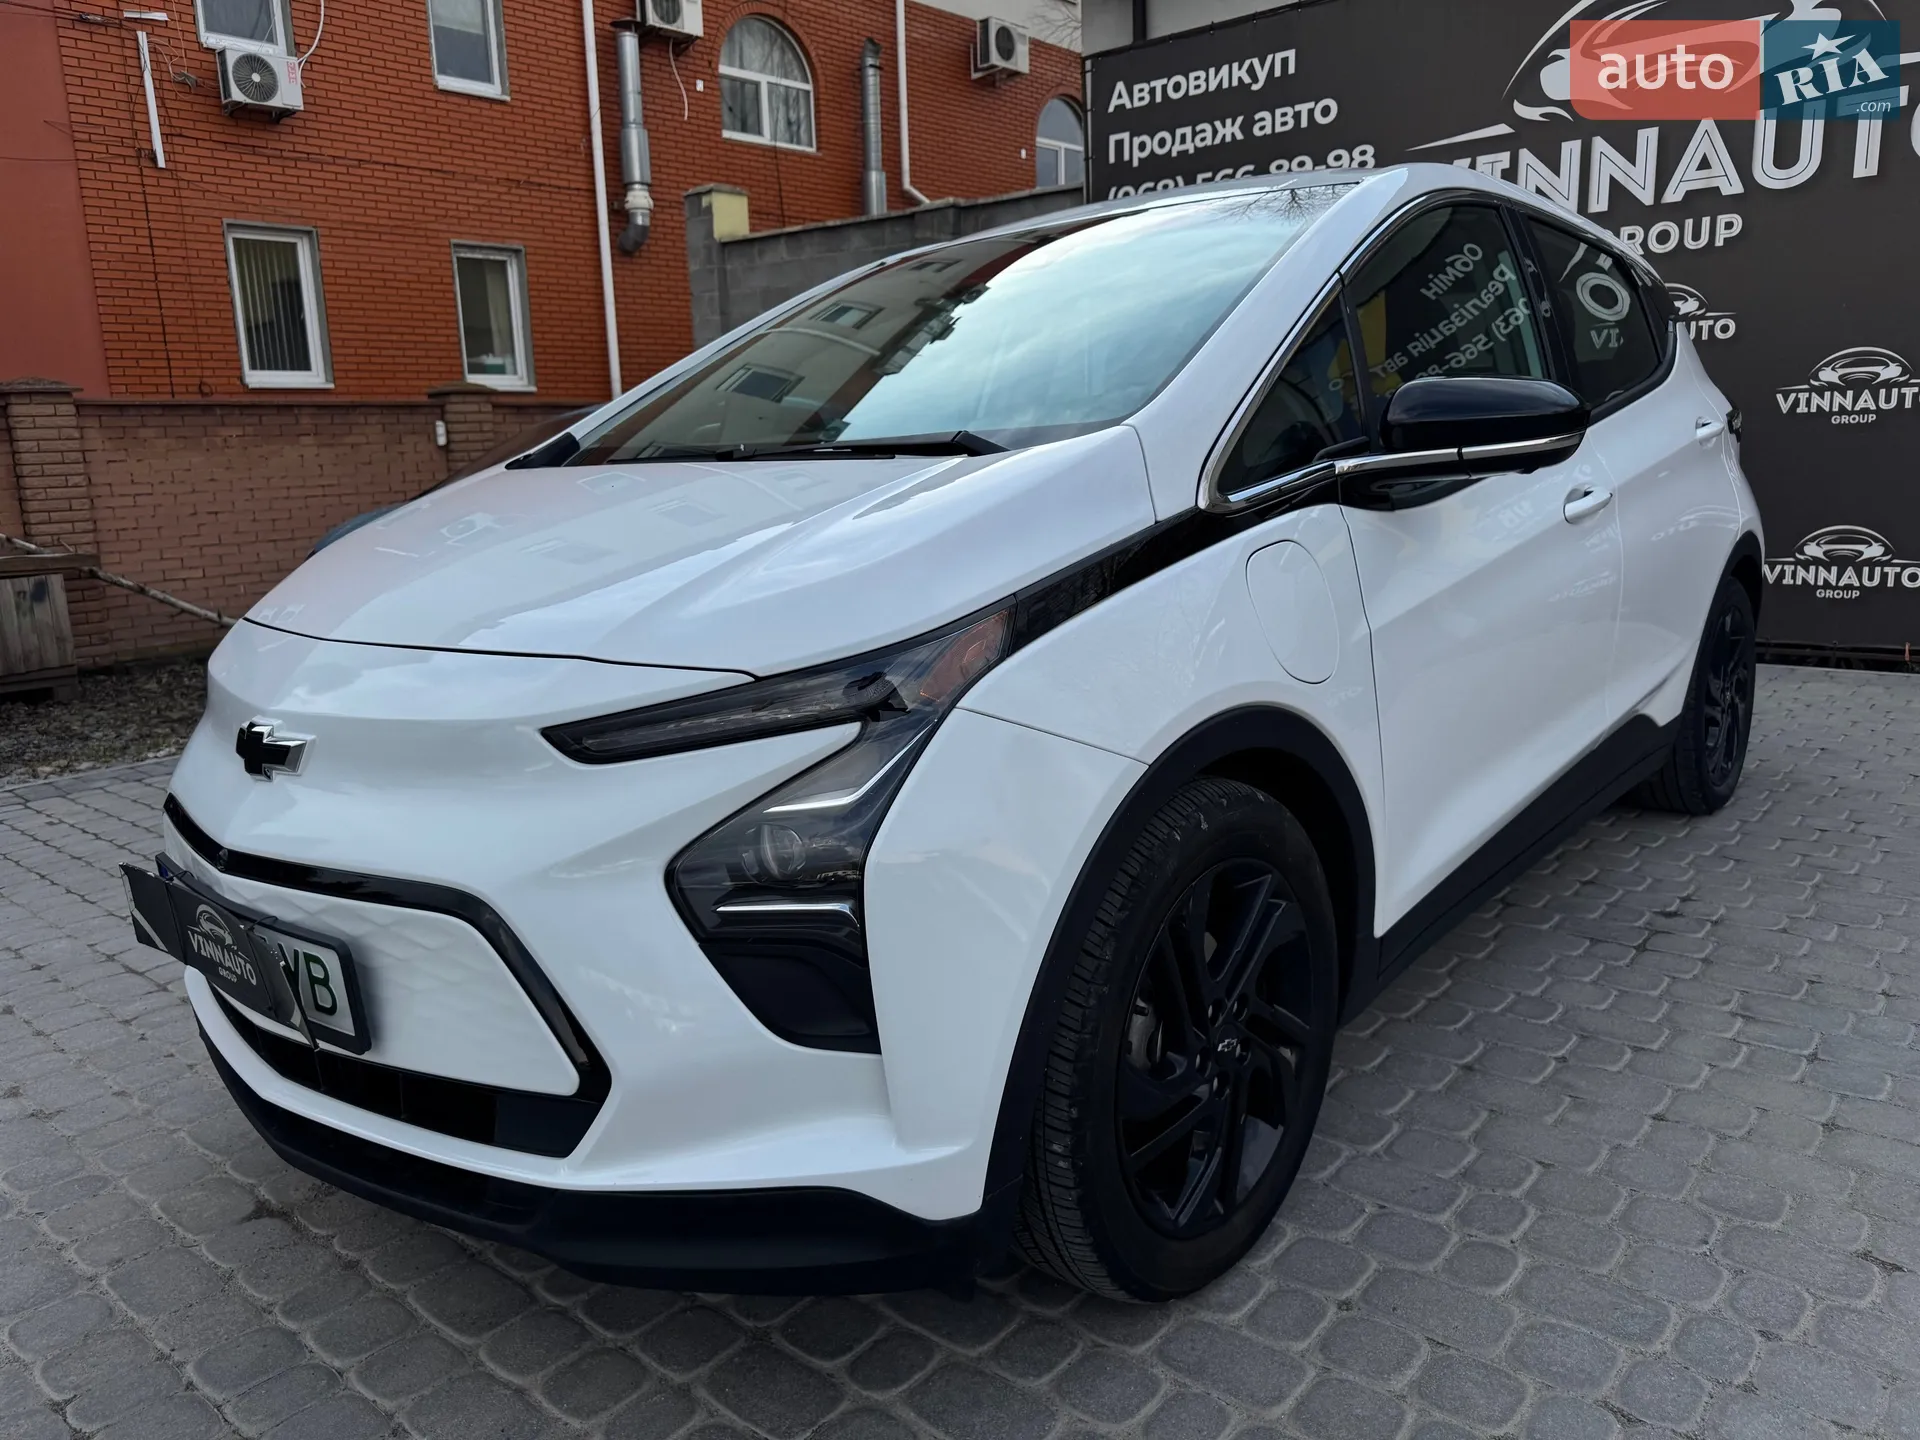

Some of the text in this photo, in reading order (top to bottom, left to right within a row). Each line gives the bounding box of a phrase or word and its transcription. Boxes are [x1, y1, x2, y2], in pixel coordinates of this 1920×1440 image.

[1107, 48, 1296, 113] Автовикуп
[1108, 97, 1339, 168] Продаж авто
[1620, 213, 1743, 255] ROUP
[1776, 386, 1920, 414] VINNAUT
[1831, 413, 1877, 424] GROUP
[1816, 589, 1860, 599] GROUP
[188, 930, 257, 986] VINNAUTO
